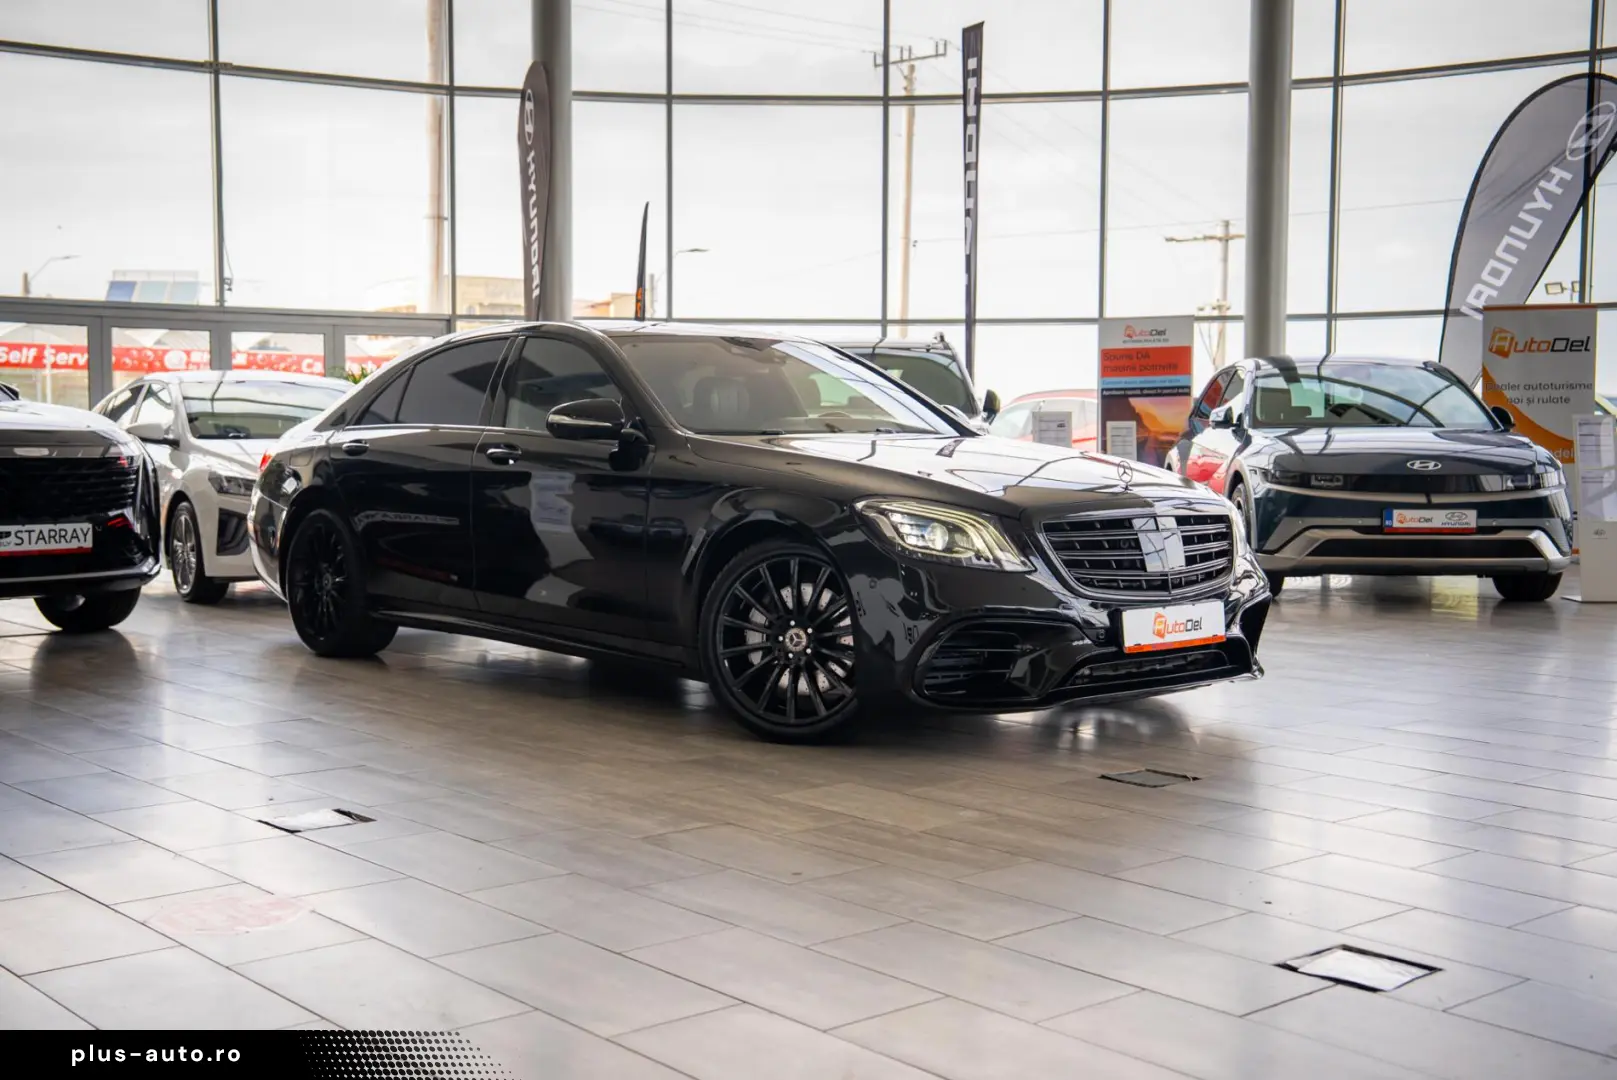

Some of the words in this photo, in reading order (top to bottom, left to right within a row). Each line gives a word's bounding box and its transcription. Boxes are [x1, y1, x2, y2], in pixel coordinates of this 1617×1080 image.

[527, 150, 540, 299] HYUNDAI
[1488, 327, 1591, 359] AutoDel
[43, 350, 88, 366] Serv
[1485, 383, 1521, 392] Dealer
[1523, 381, 1593, 391] autoturisme
[1537, 396, 1571, 405] rulate
[14, 527, 91, 546] STARRAY
[1153, 612, 1203, 639] AutoDel
